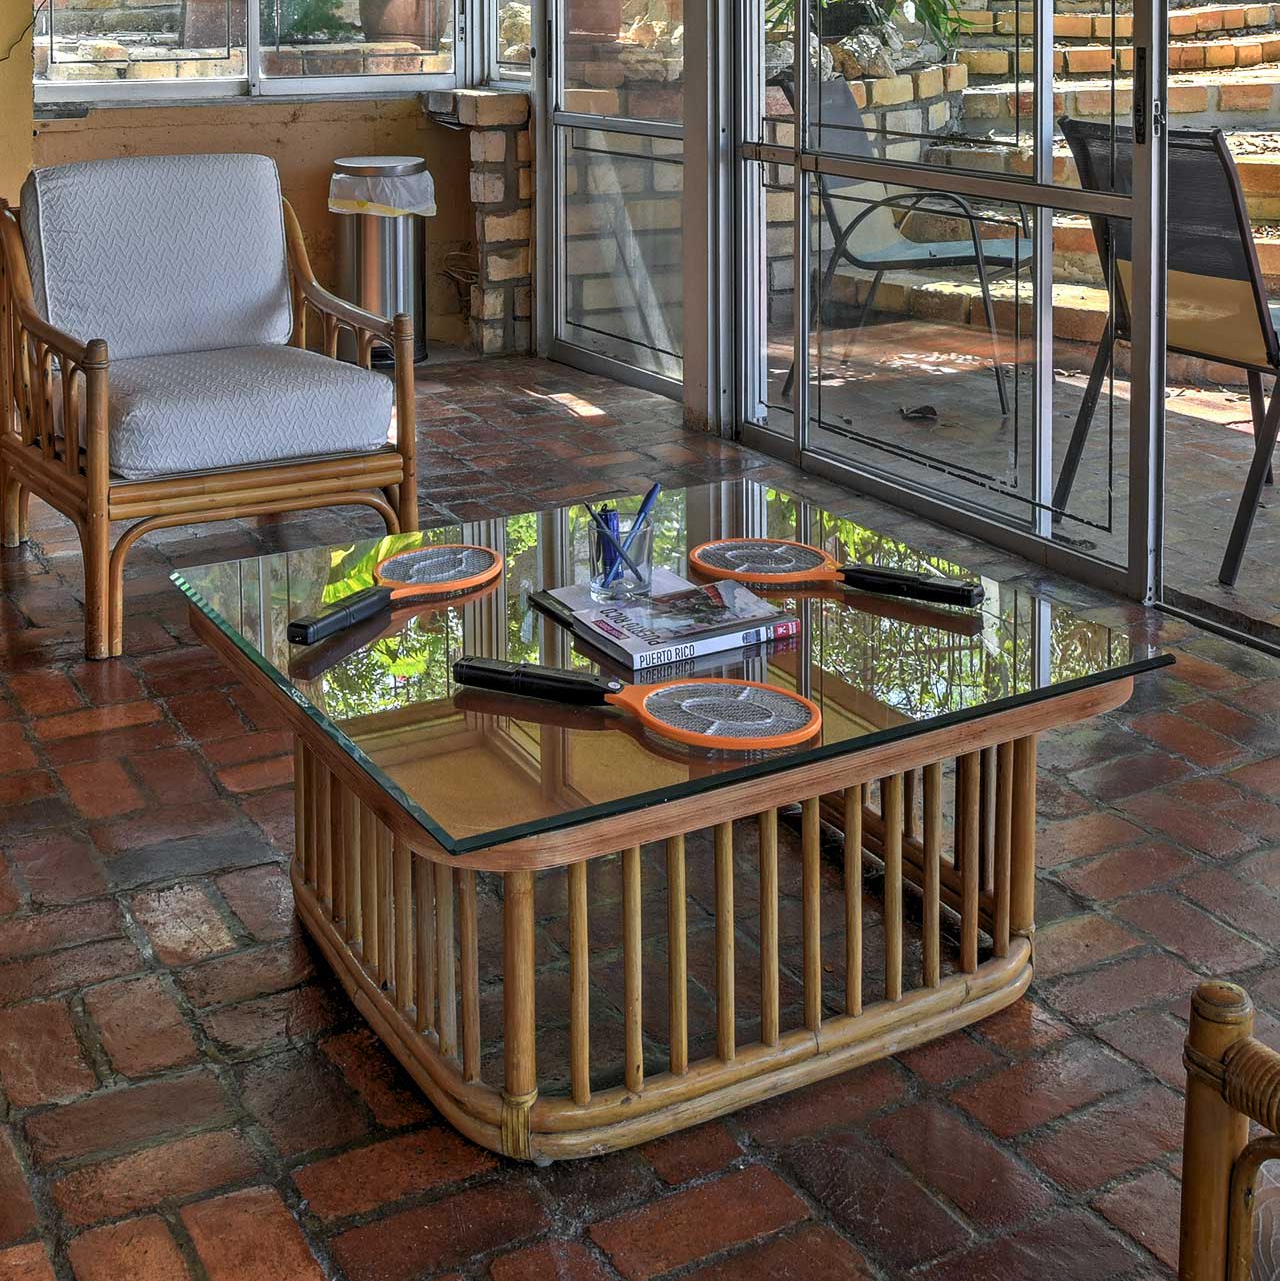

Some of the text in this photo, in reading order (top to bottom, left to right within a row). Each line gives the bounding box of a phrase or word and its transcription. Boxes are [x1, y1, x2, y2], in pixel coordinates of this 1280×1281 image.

[622, 622, 667, 646] PUERTO
[639, 644, 695, 668] PUERTO RICO
